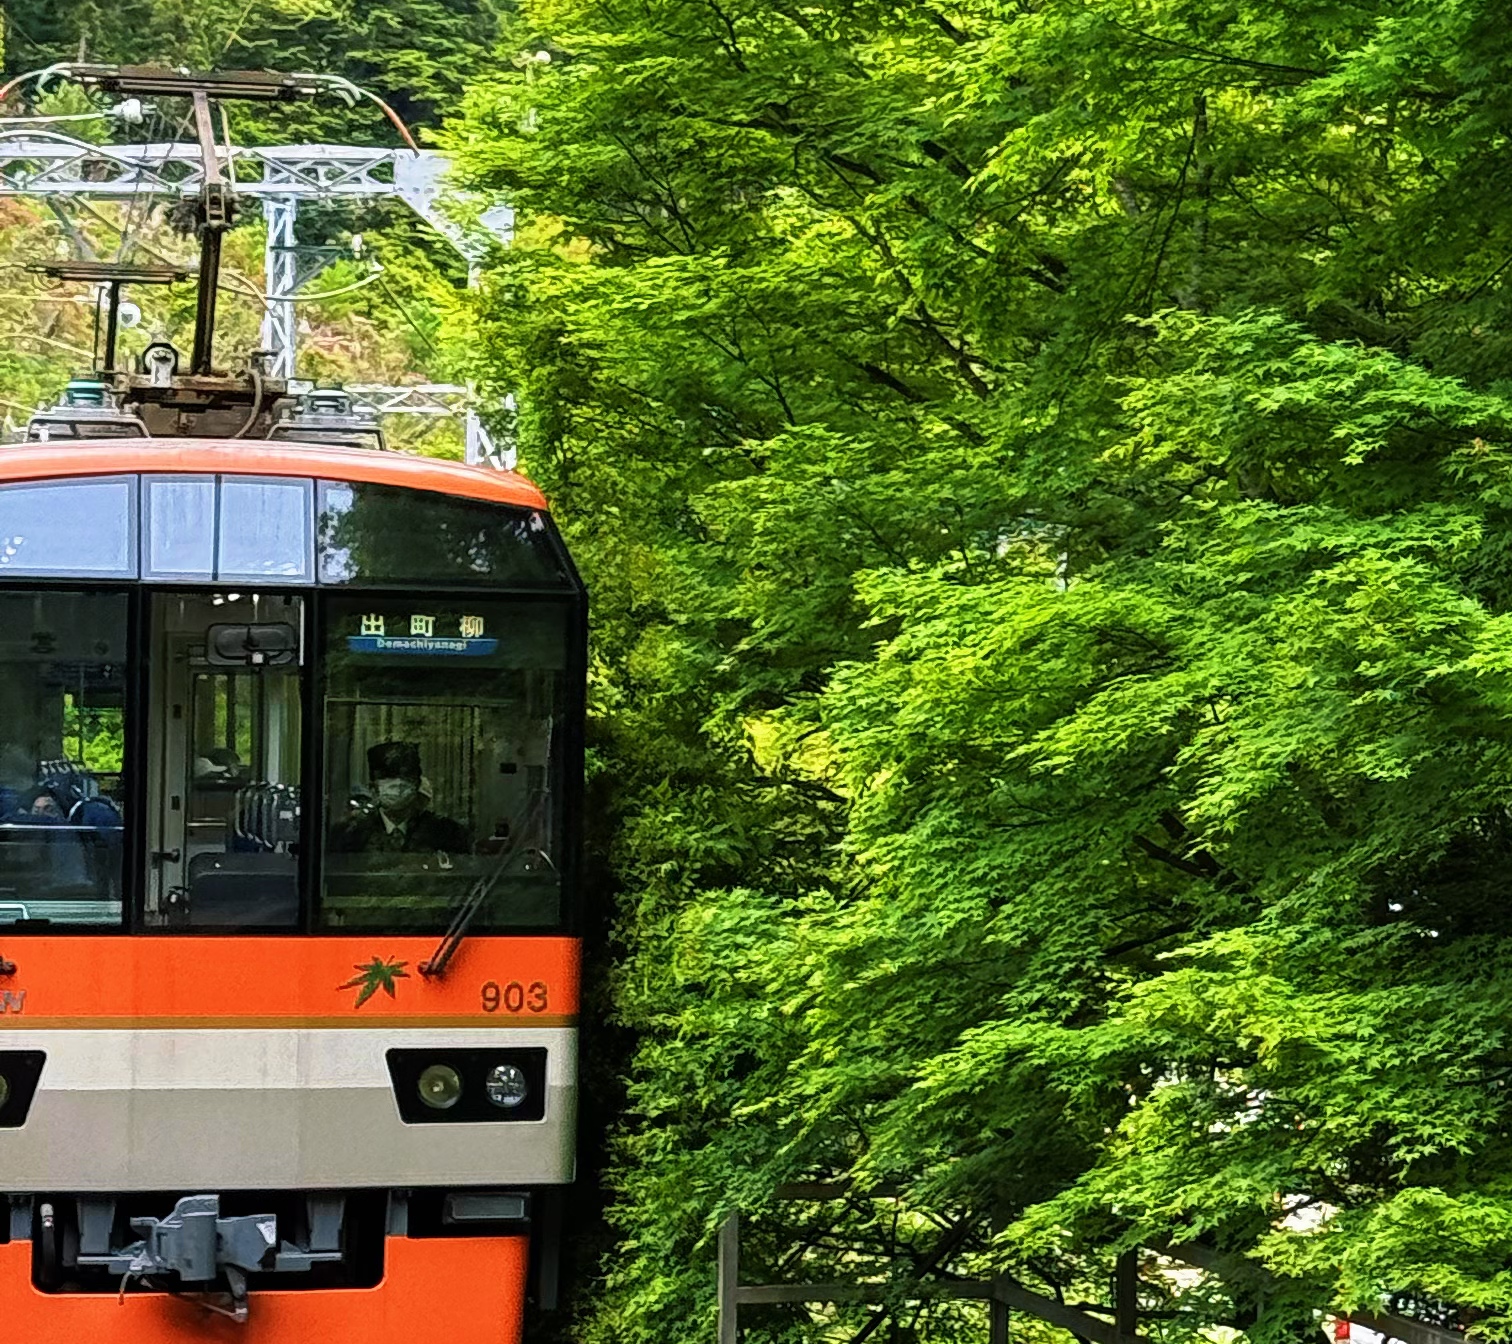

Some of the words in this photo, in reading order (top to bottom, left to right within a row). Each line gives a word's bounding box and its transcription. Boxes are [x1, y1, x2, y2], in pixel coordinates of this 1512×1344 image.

[361, 613, 484, 638] 出町柳
[377, 638, 467, 651] Demachiyanagi
[481, 981, 548, 1012] 903
